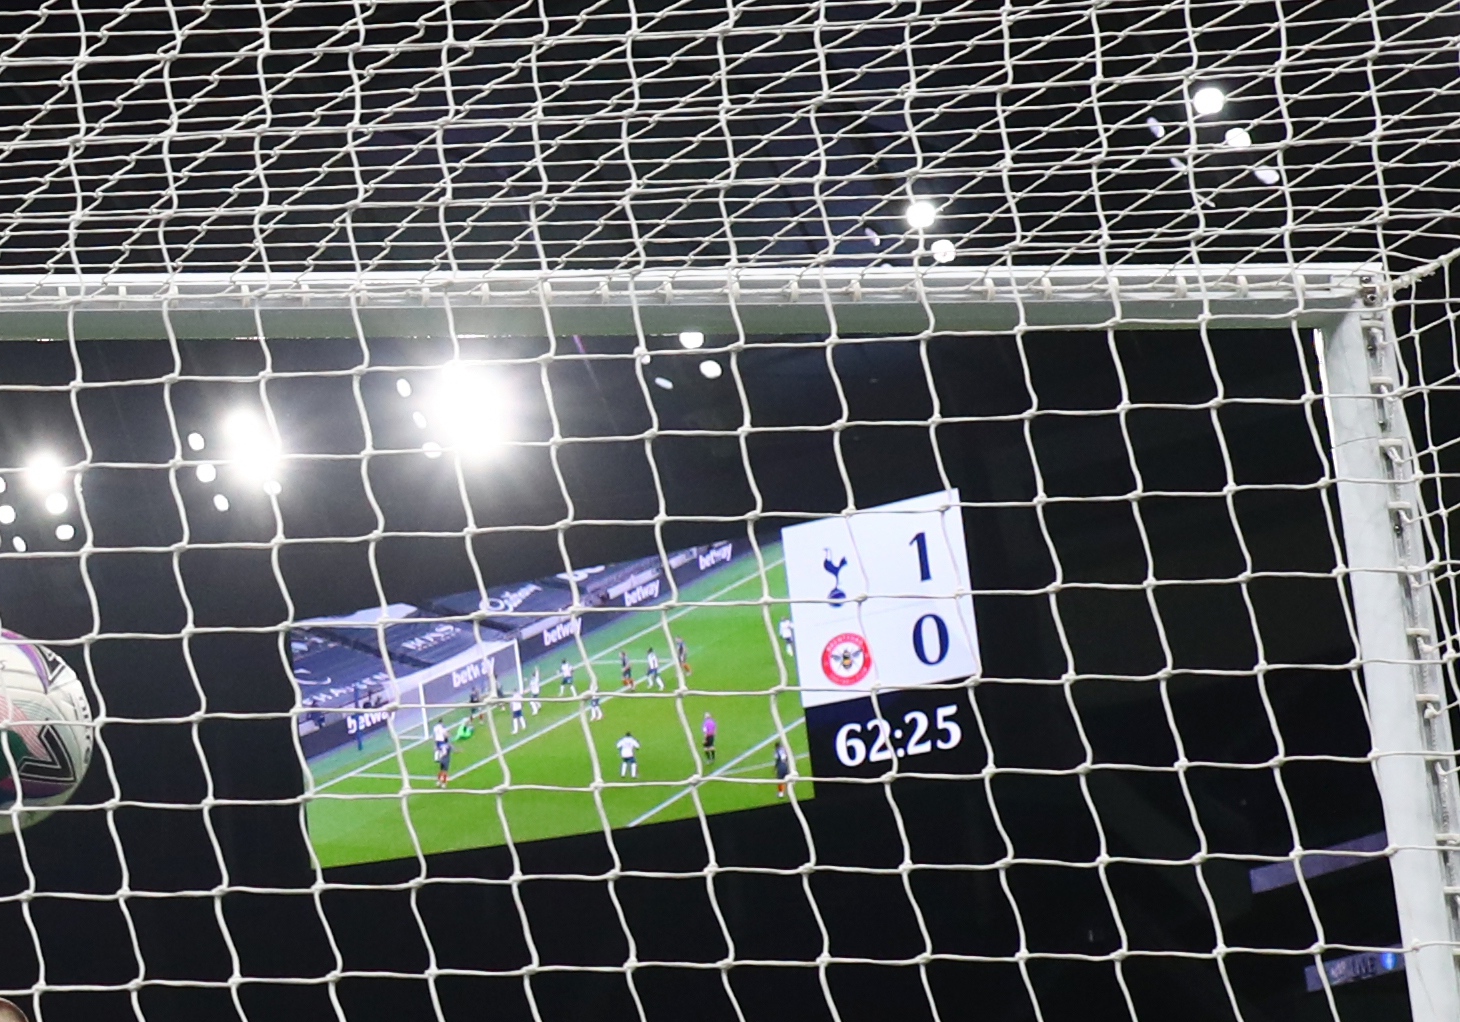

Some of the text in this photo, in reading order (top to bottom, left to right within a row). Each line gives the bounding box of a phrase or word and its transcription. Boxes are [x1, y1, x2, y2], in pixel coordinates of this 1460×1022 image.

[909, 532, 932, 583] 1
[624, 579, 661, 607] betway
[912, 614, 950, 667] 0
[835, 704, 962, 767] 62:25
